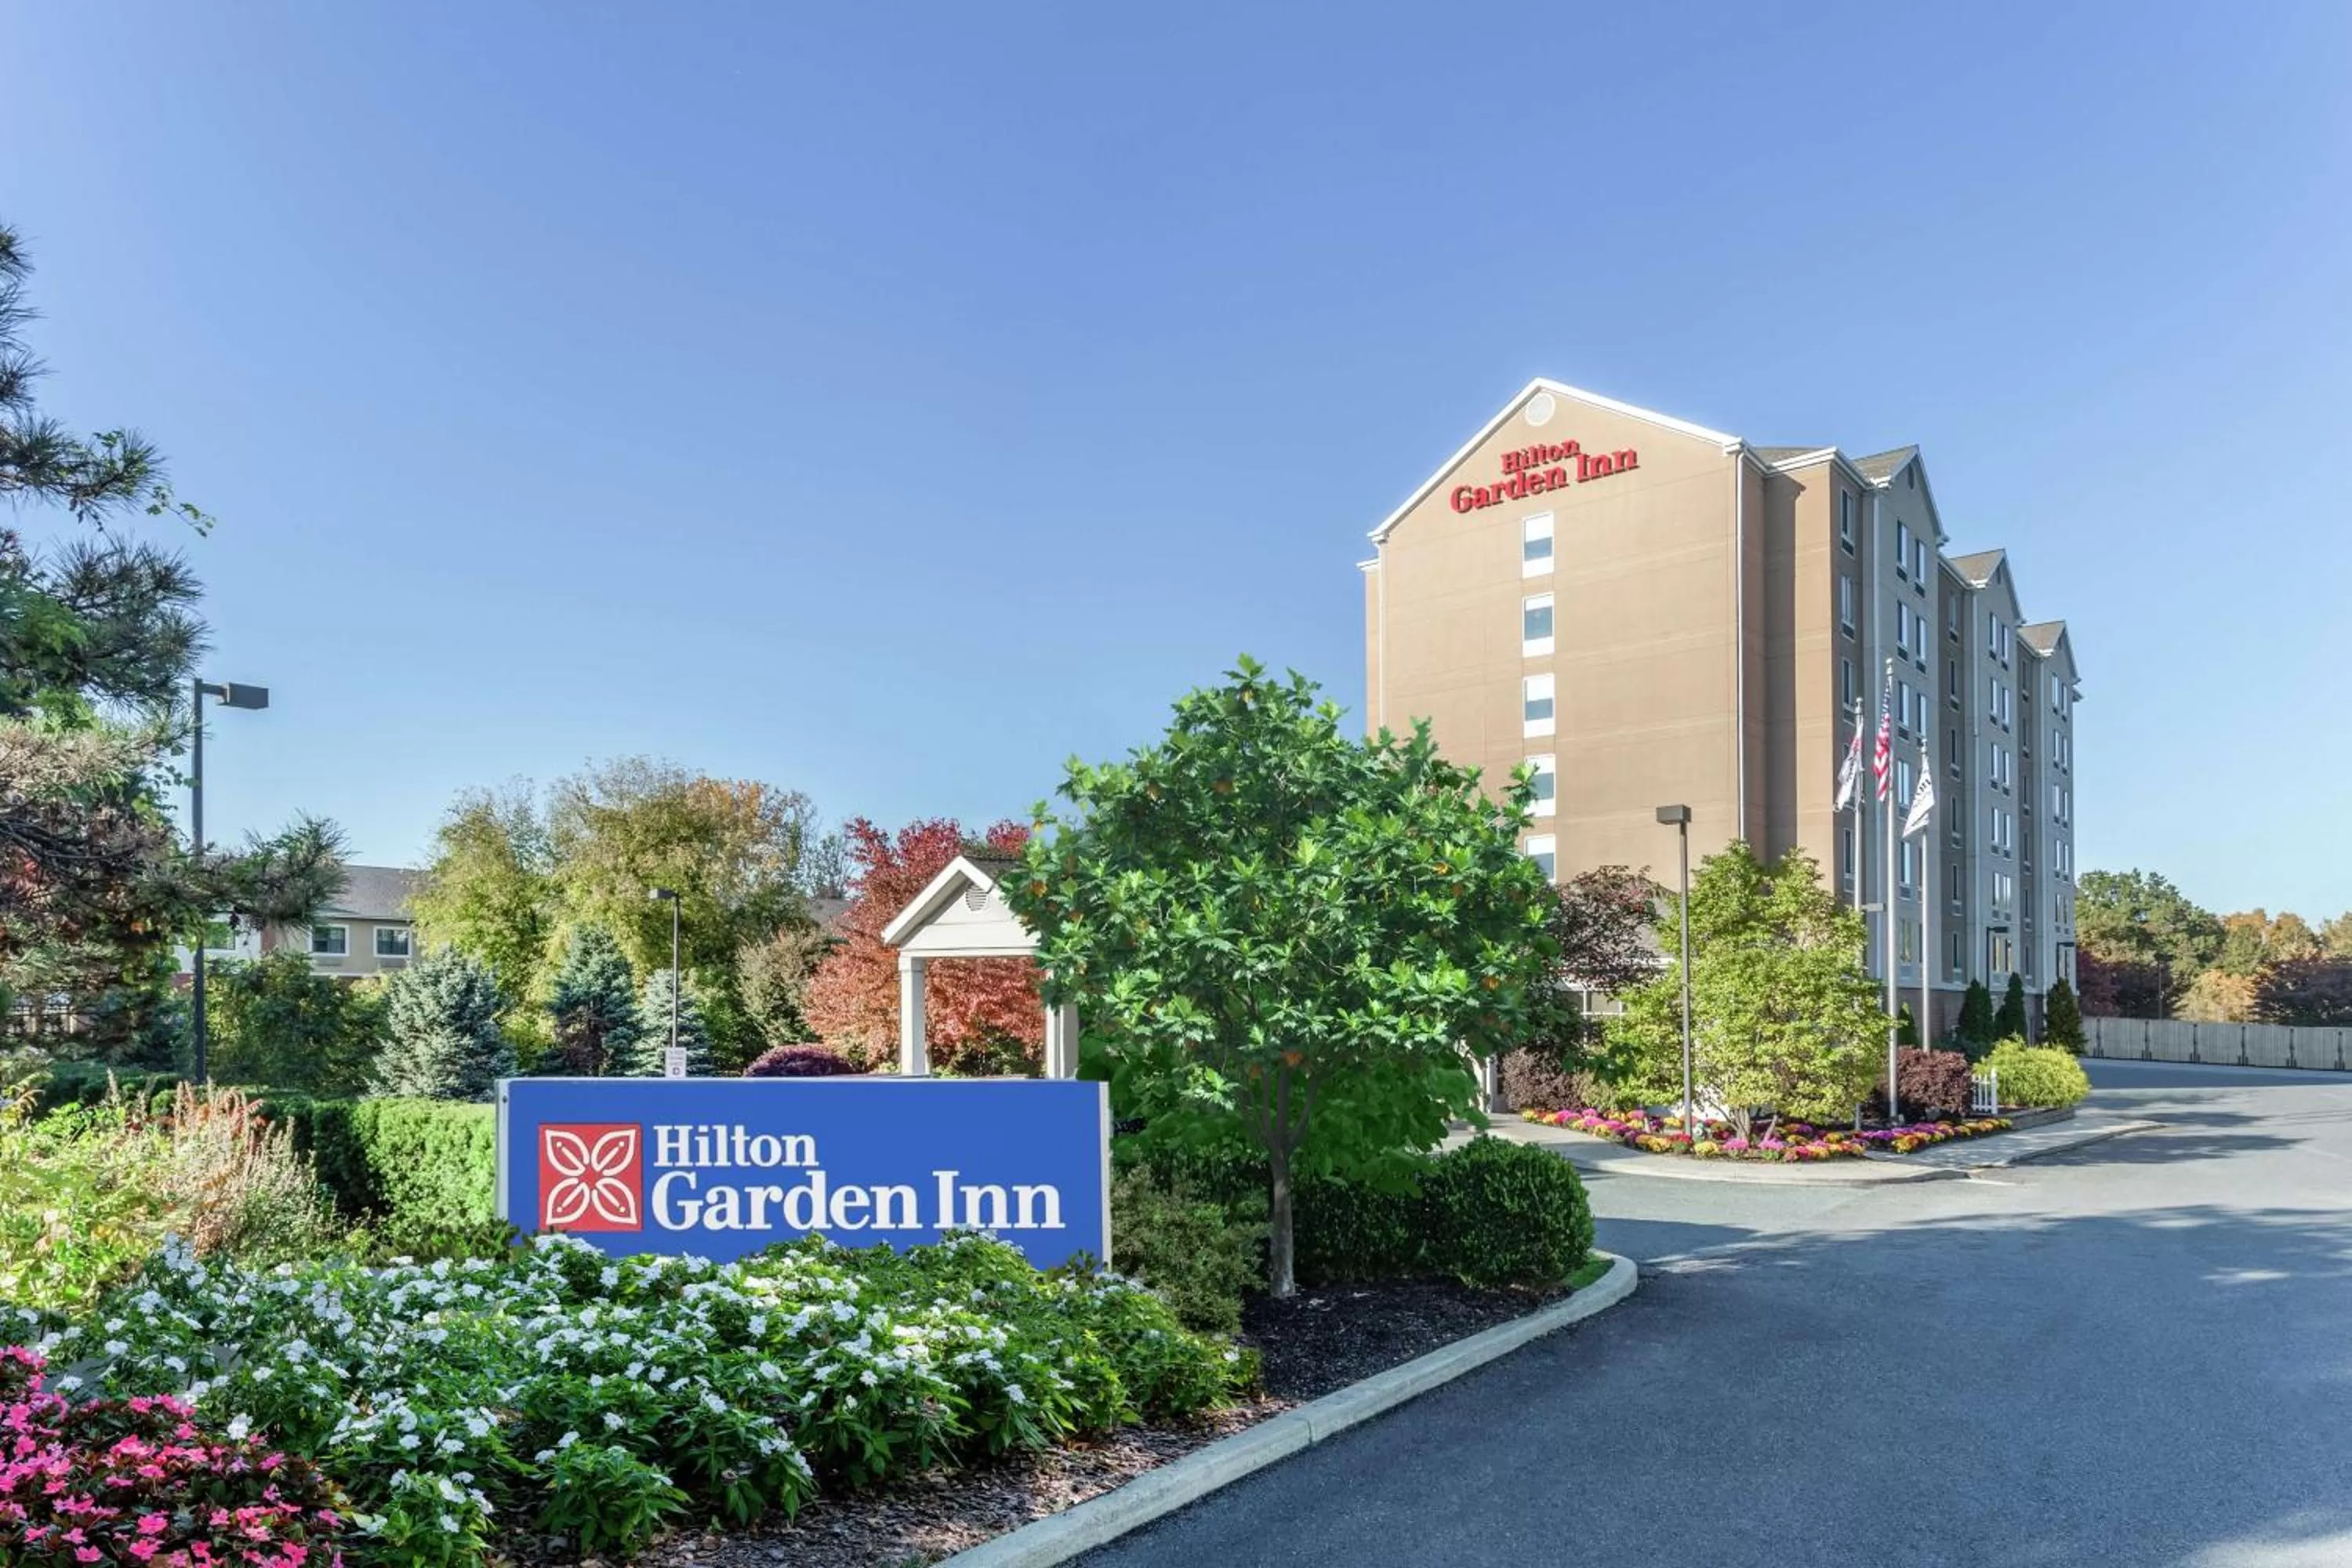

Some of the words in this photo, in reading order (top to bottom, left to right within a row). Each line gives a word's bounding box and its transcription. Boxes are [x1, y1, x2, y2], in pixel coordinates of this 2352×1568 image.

[1450, 469, 1568, 514] Garden
[1575, 447, 1639, 483] Inn
[1500, 438, 1581, 474] Hilton
[652, 1124, 818, 1167] Hilton
[652, 1171, 923, 1230] Garden
[932, 1171, 1065, 1229] Inn
